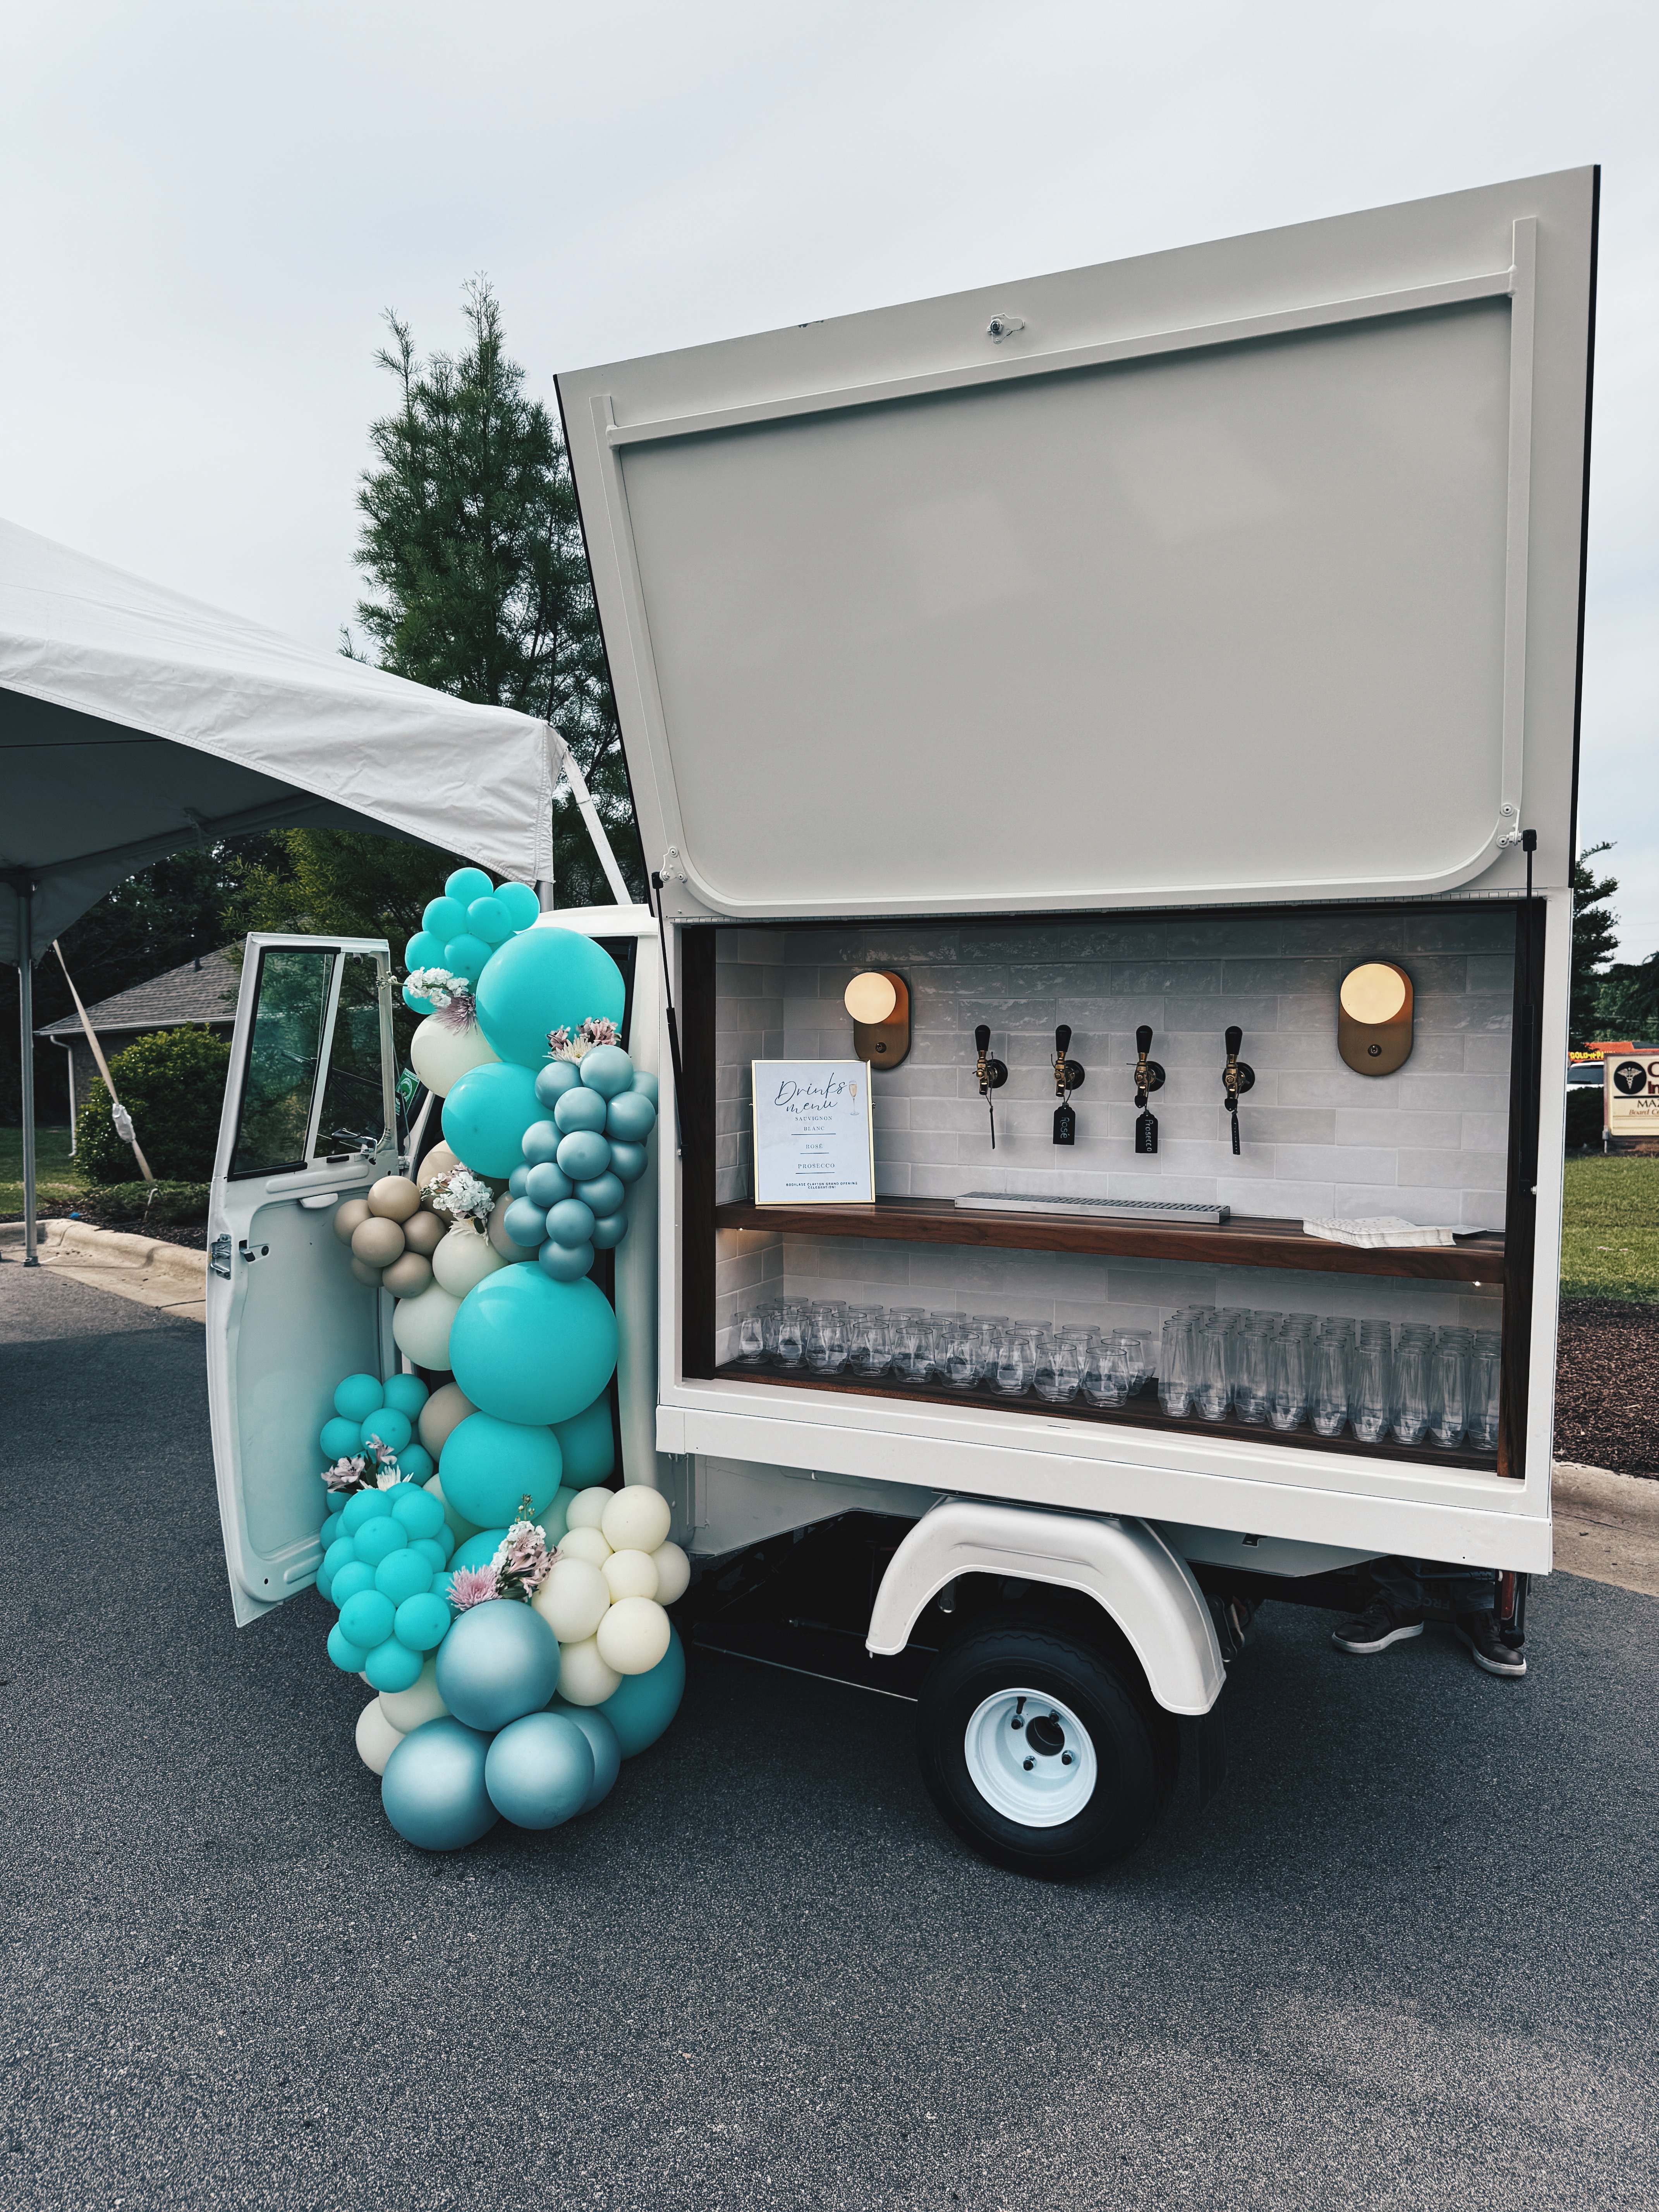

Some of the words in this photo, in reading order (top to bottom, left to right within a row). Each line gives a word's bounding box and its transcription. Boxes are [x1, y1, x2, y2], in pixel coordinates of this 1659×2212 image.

[775, 1072, 847, 1106] Drinks
[787, 1100, 838, 1113] menu
[1060, 1117, 1070, 1139] Rosé
[1145, 1120, 1153, 1152] Prosecco
